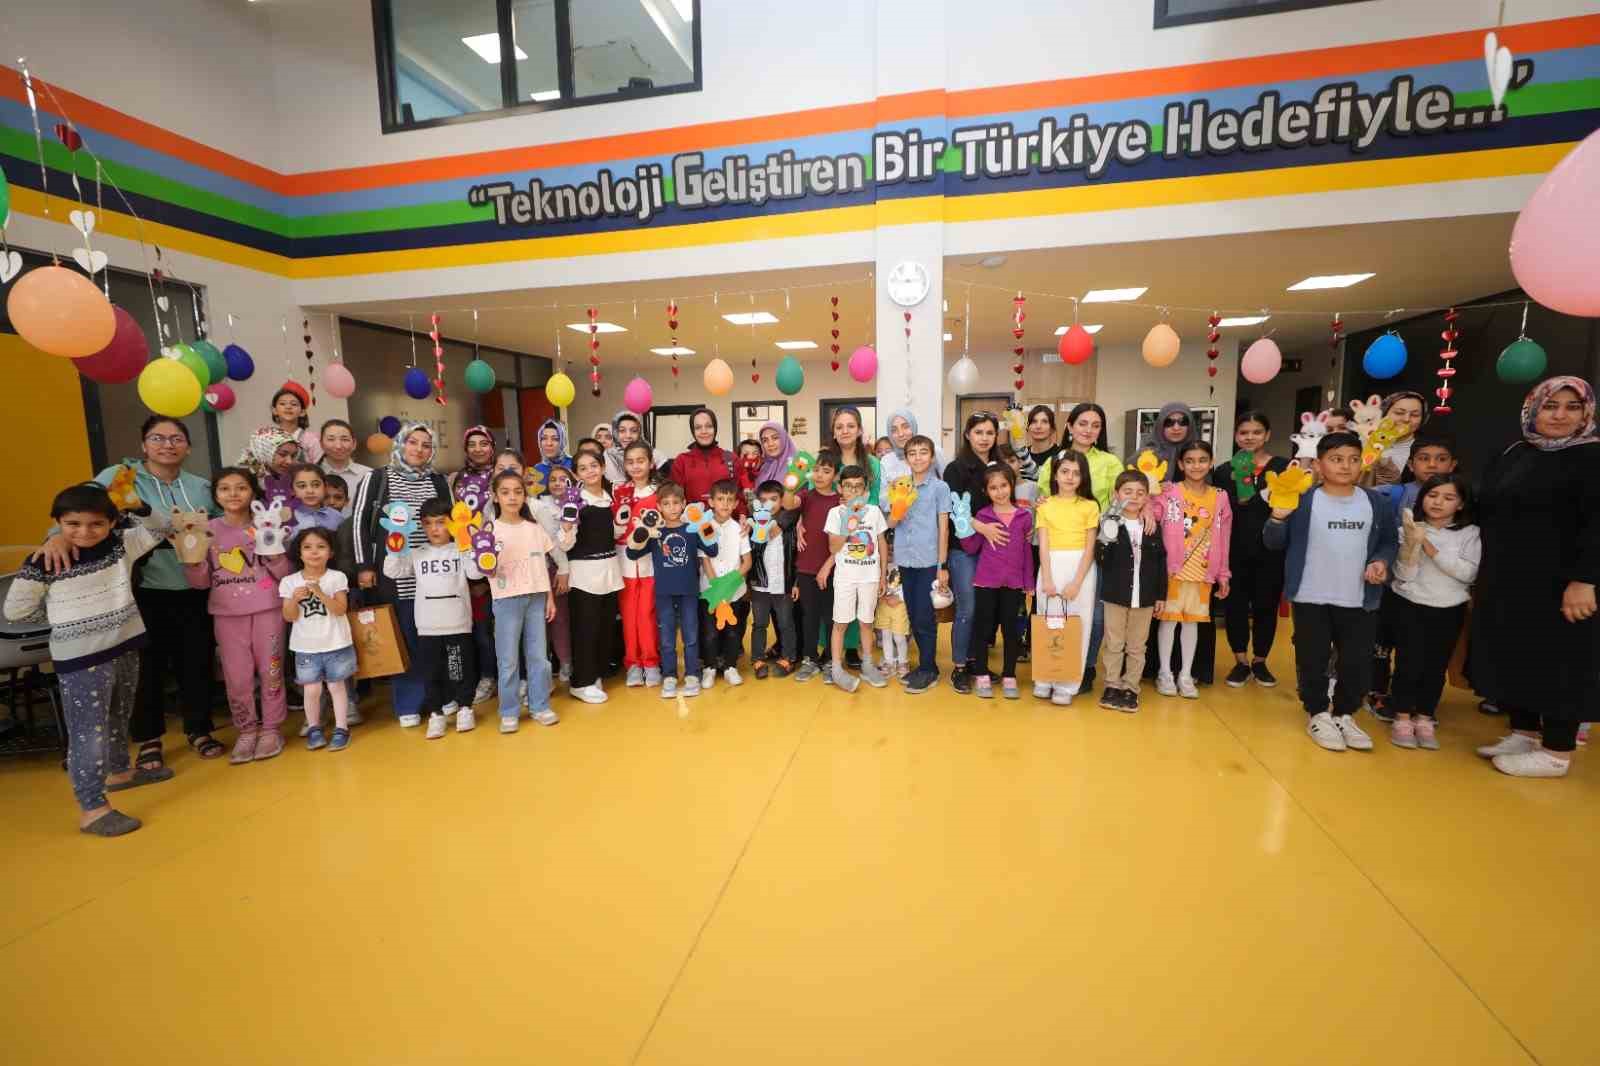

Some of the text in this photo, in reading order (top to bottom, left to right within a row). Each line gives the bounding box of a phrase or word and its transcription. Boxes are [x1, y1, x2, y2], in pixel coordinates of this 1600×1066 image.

[673, 151, 864, 204] Geliştiren
[873, 131, 945, 183] Bir
[954, 115, 1148, 177] Türkiye
[1327, 518, 1365, 530] miav
[420, 559, 461, 575] BEST
